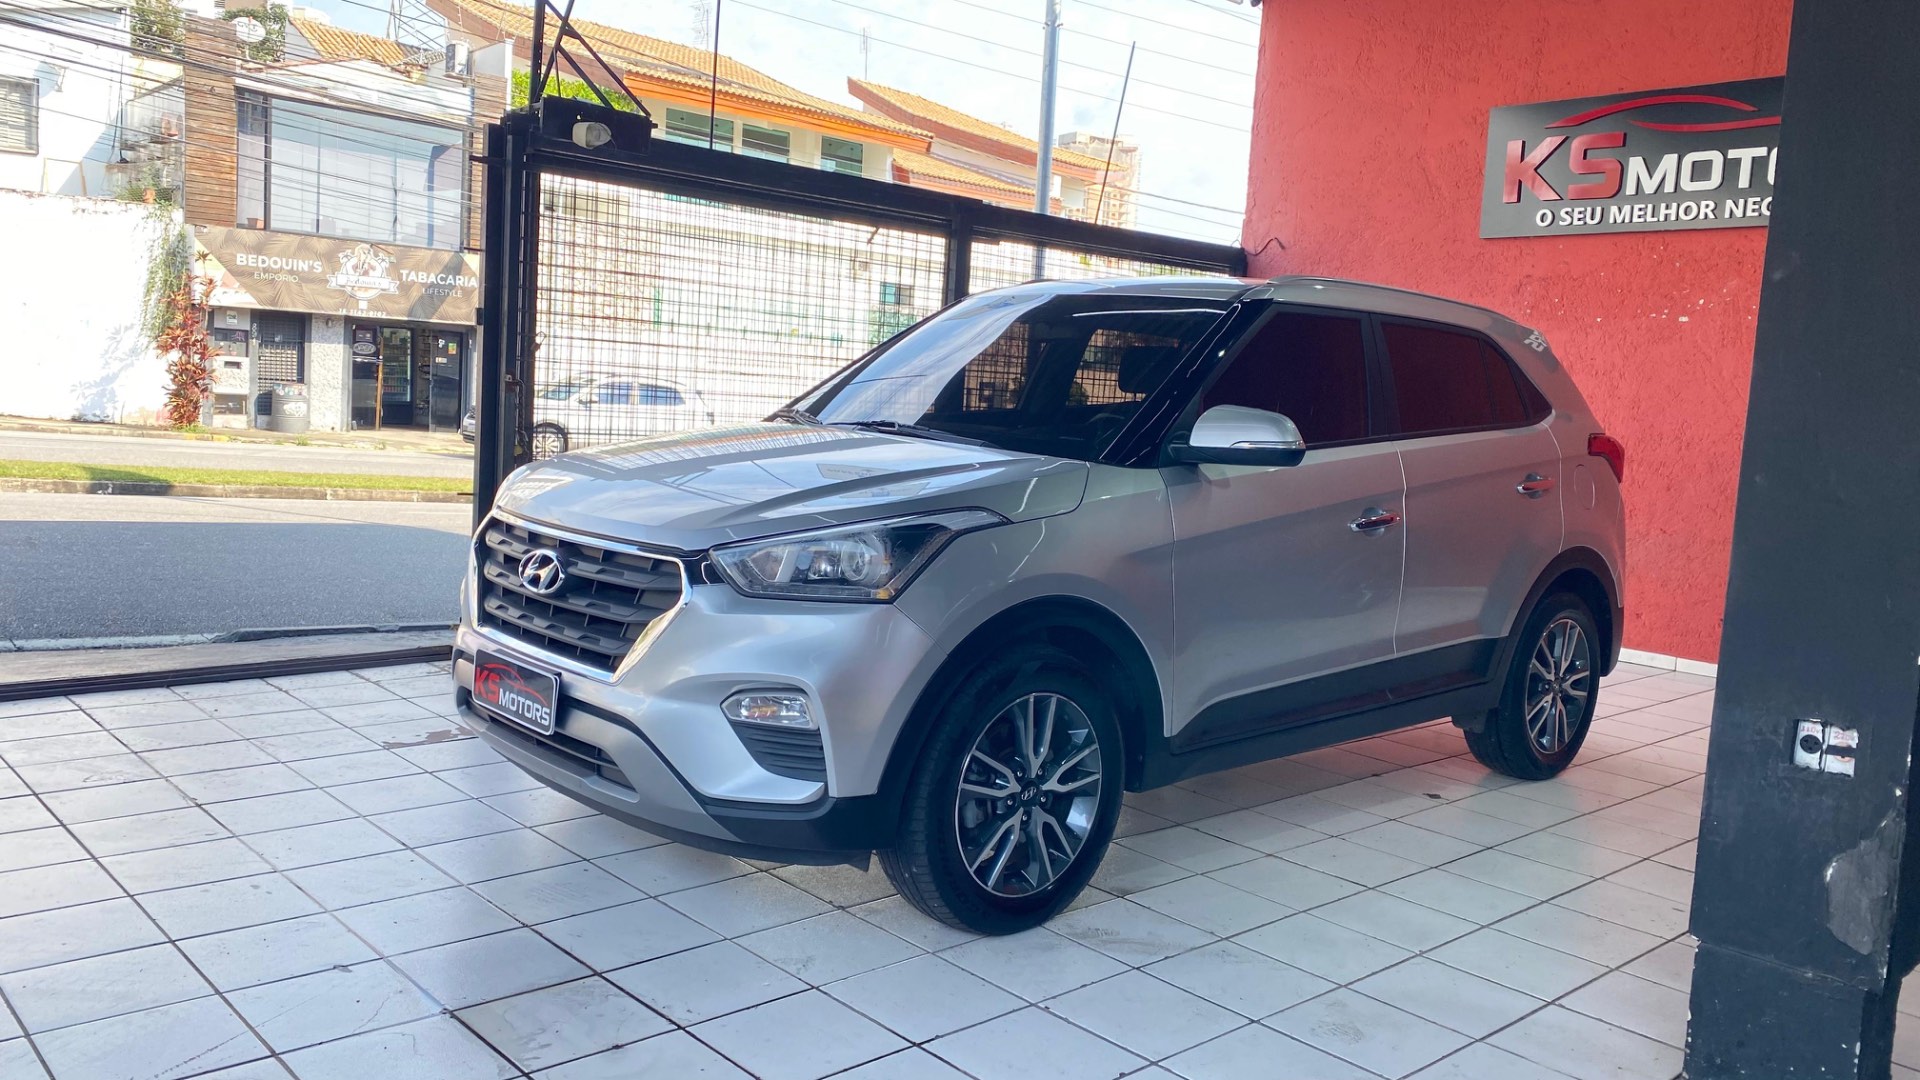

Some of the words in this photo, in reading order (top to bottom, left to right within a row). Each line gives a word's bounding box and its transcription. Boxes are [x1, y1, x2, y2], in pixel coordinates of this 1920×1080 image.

[1503, 132, 1625, 203] KS
[1626, 146, 1778, 196] MOT
[1536, 208, 1553, 227] O
[1559, 206, 1602, 226] SEU
[1609, 200, 1715, 224] MELHOR
[236, 252, 323, 273] BEDOUIN'S
[254, 272, 299, 283] EMPORIO
[400, 269, 478, 288] TABACARIA
[422, 287, 463, 298] LIFESTYLE
[475, 667, 499, 703] KS
[499, 689, 550, 725] MOTORS
